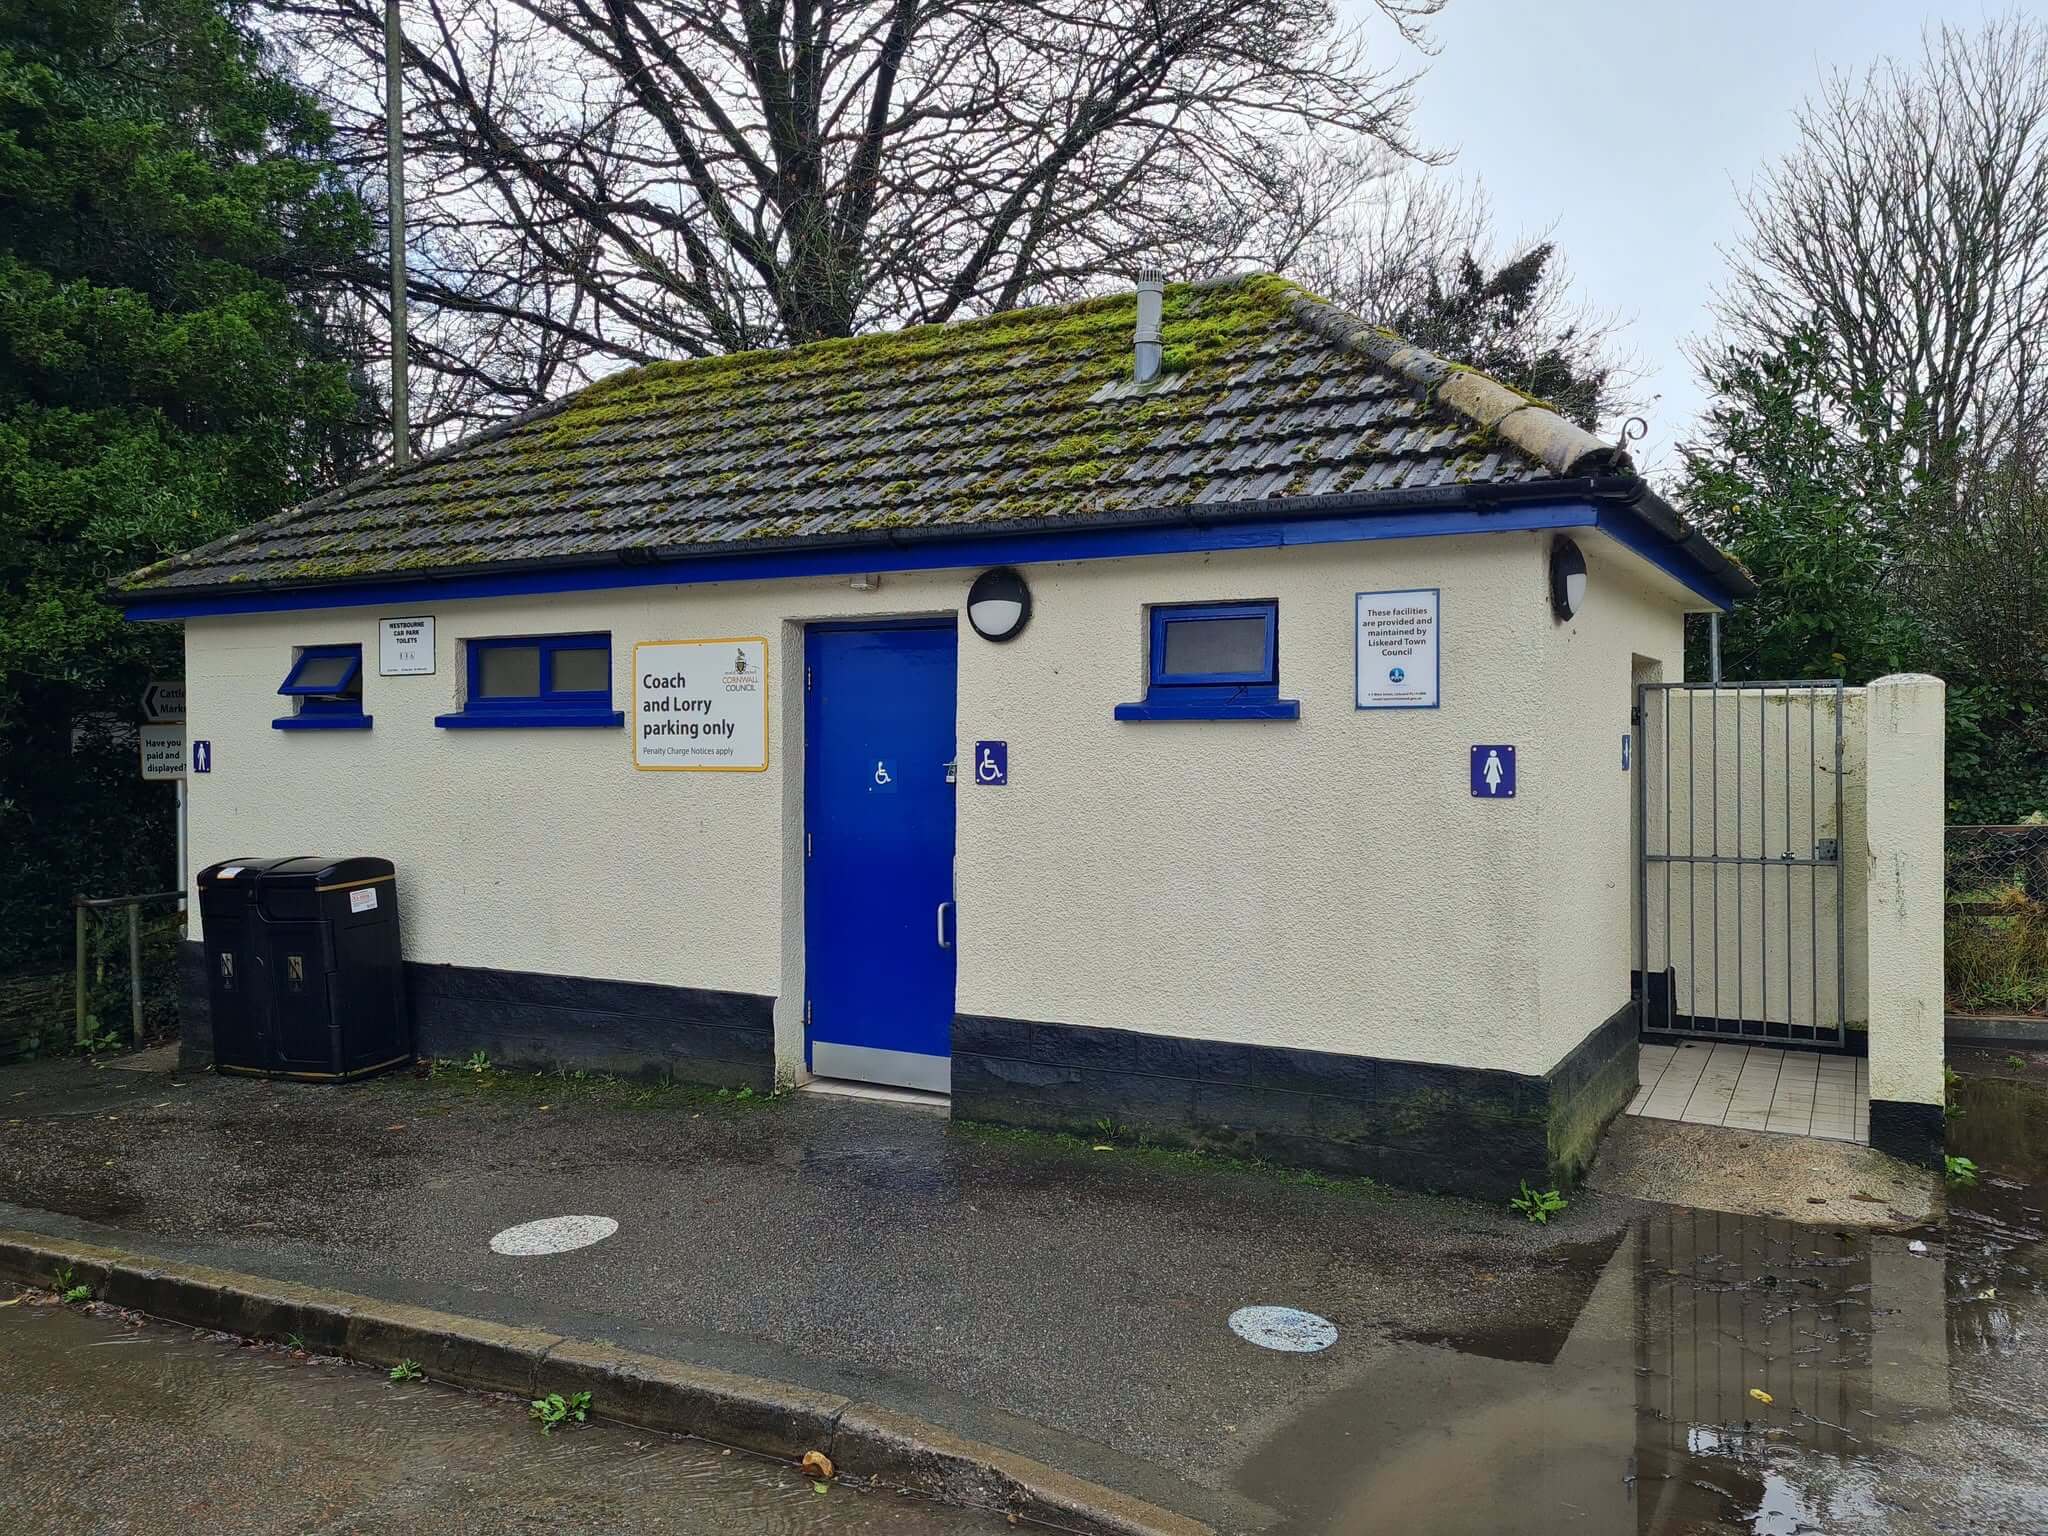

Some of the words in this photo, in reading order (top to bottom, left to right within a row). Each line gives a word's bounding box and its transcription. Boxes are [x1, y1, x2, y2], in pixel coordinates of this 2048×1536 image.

[1377, 618, 1414, 628] provided
[1416, 617, 1433, 625] and
[1368, 628, 1415, 636] maintained
[1416, 627, 1427, 636] by
[1368, 638, 1403, 647] Liskeard
[1404, 638, 1426, 646] Town
[1381, 648, 1413, 657] Council
[643, 672, 686, 689] Coach
[722, 676, 758, 684] CORNWALL
[725, 684, 756, 692] COUNCIL
[643, 696, 670, 712] and
[673, 697, 712, 715] Lorry
[643, 719, 699, 739] parking
[702, 719, 735, 739] only
[145, 739, 166, 747] Have
[167, 740, 182, 748] you
[146, 751, 164, 760] paid
[165, 751, 180, 759] and
[643, 747, 666, 756] Penalty
[667, 747, 690, 756] Charge
[690, 747, 715, 755] Notices
[715, 748, 734, 756] apply
